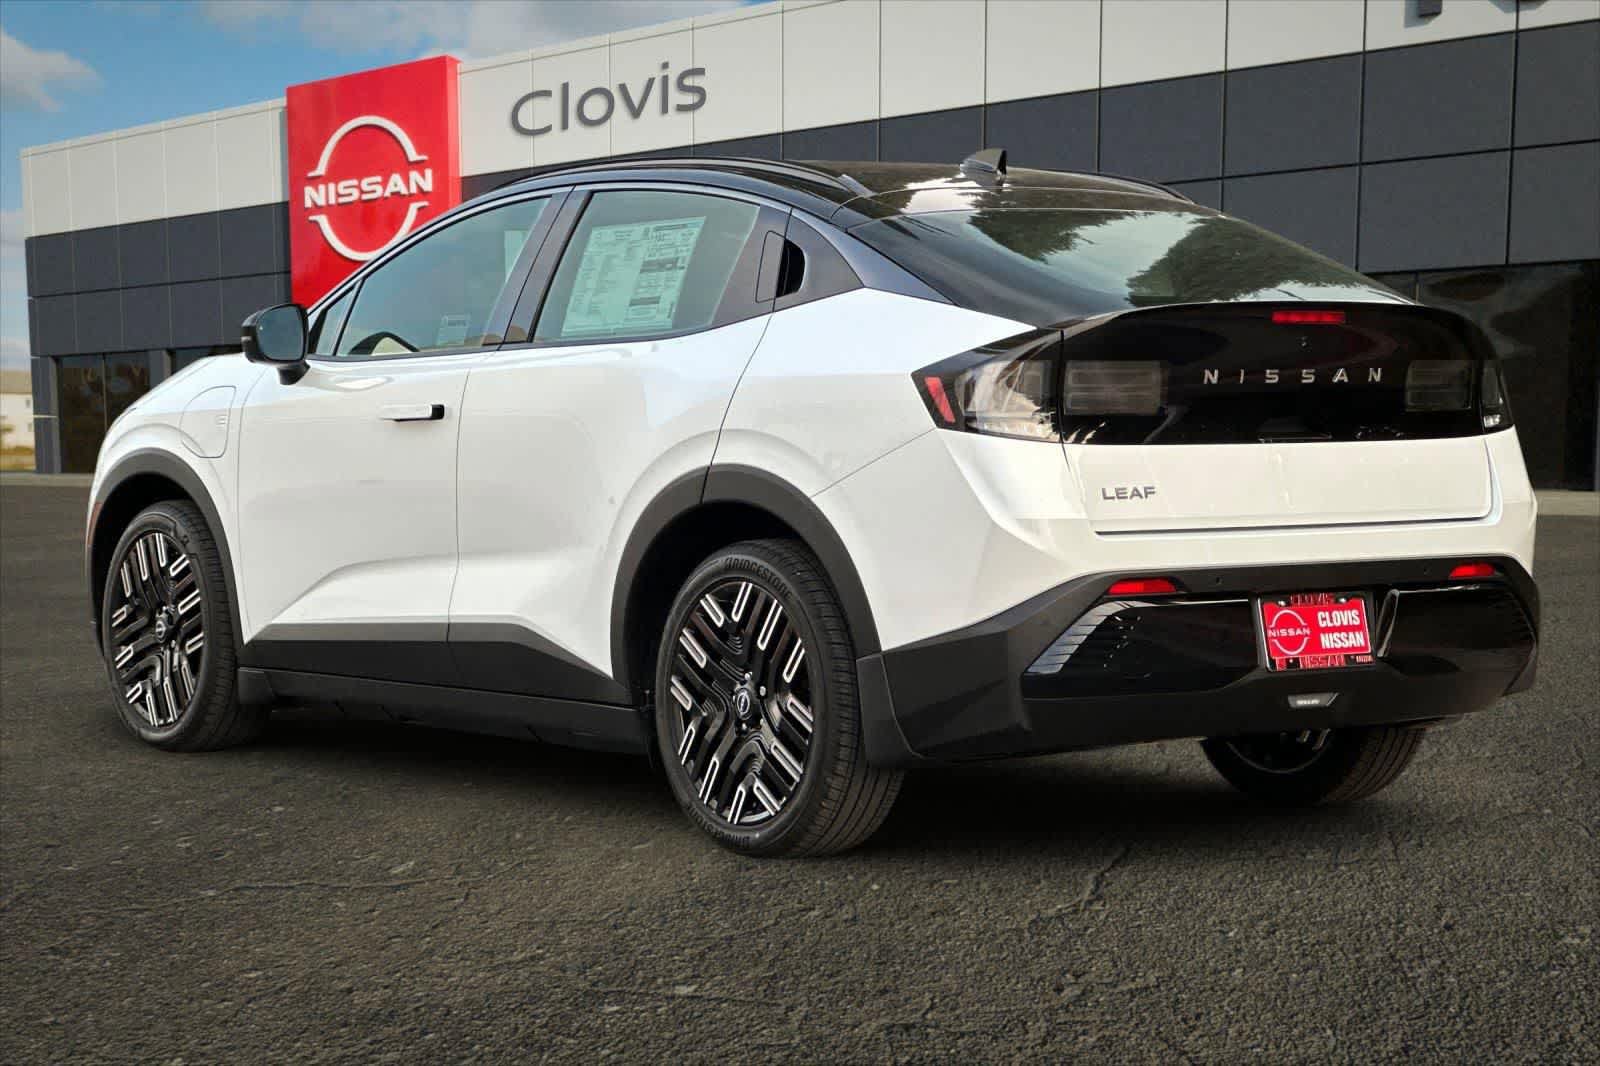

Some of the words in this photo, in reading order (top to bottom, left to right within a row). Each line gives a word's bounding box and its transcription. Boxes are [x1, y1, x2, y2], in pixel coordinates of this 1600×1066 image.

[511, 61, 707, 136] Clovis
[304, 168, 433, 208] NISSAN
[1203, 367, 1383, 385] NISSAN
[1101, 486, 1156, 500] LEAF
[1317, 609, 1361, 628] CLOVIS
[1267, 627, 1311, 638] NISSAN
[1320, 631, 1365, 649] NISSAN
